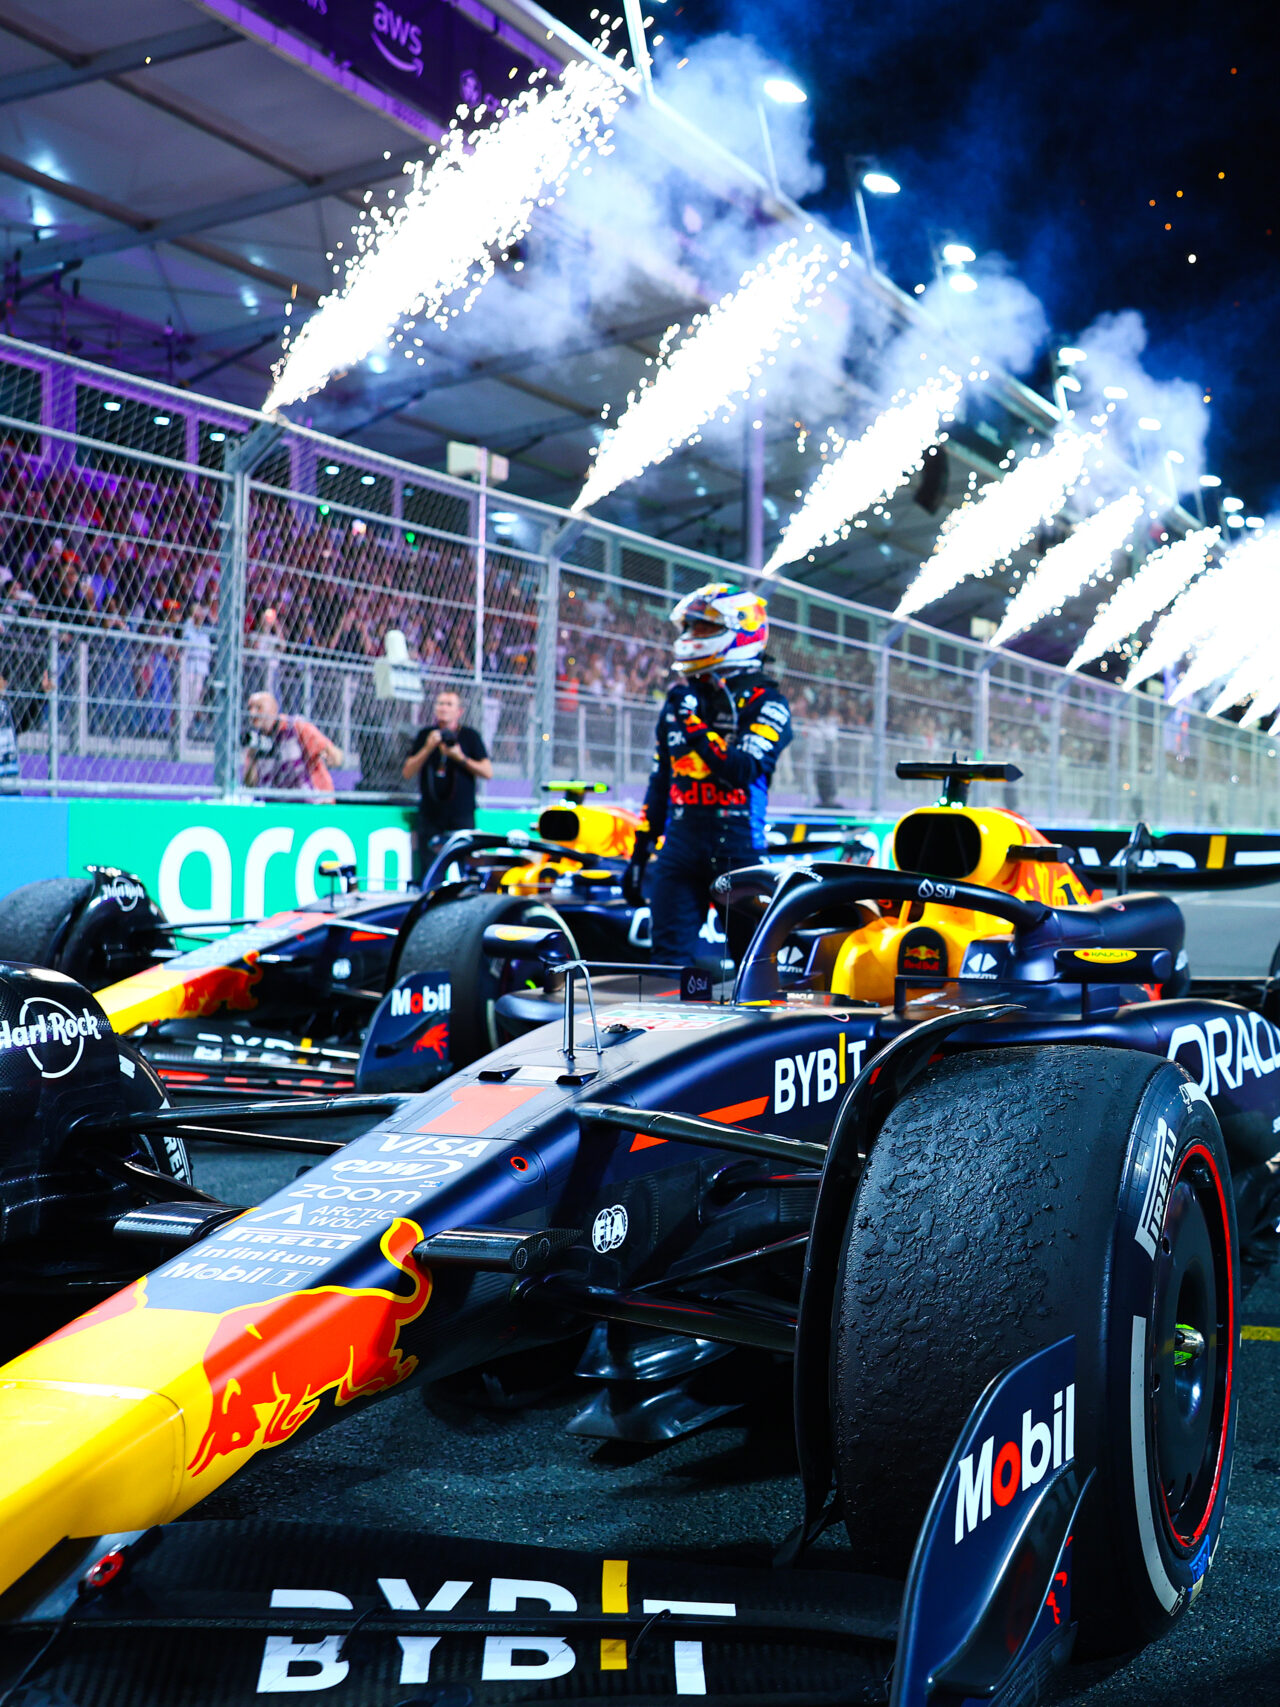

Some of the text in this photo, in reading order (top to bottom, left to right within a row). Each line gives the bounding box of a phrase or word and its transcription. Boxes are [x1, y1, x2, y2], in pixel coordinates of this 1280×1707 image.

[373, 1, 422, 56] aws
[391, 983, 452, 1018] Mobil
[47, 1008, 102, 1046] Rock
[774, 1032, 867, 1115] BYBIT
[380, 1134, 492, 1158] VISA
[330, 1159, 430, 1177] CDW
[288, 1183, 423, 1205] zoom
[1134, 1117, 1177, 1261] PIRELLI
[307, 1215, 378, 1230] WOLF
[308, 1204, 398, 1221] ARCTIC
[217, 1226, 362, 1250] PIRELLI
[160, 1262, 272, 1284] Mobil
[954, 1383, 1076, 1545] Mobil
[256, 1559, 737, 1697] BYBIT
